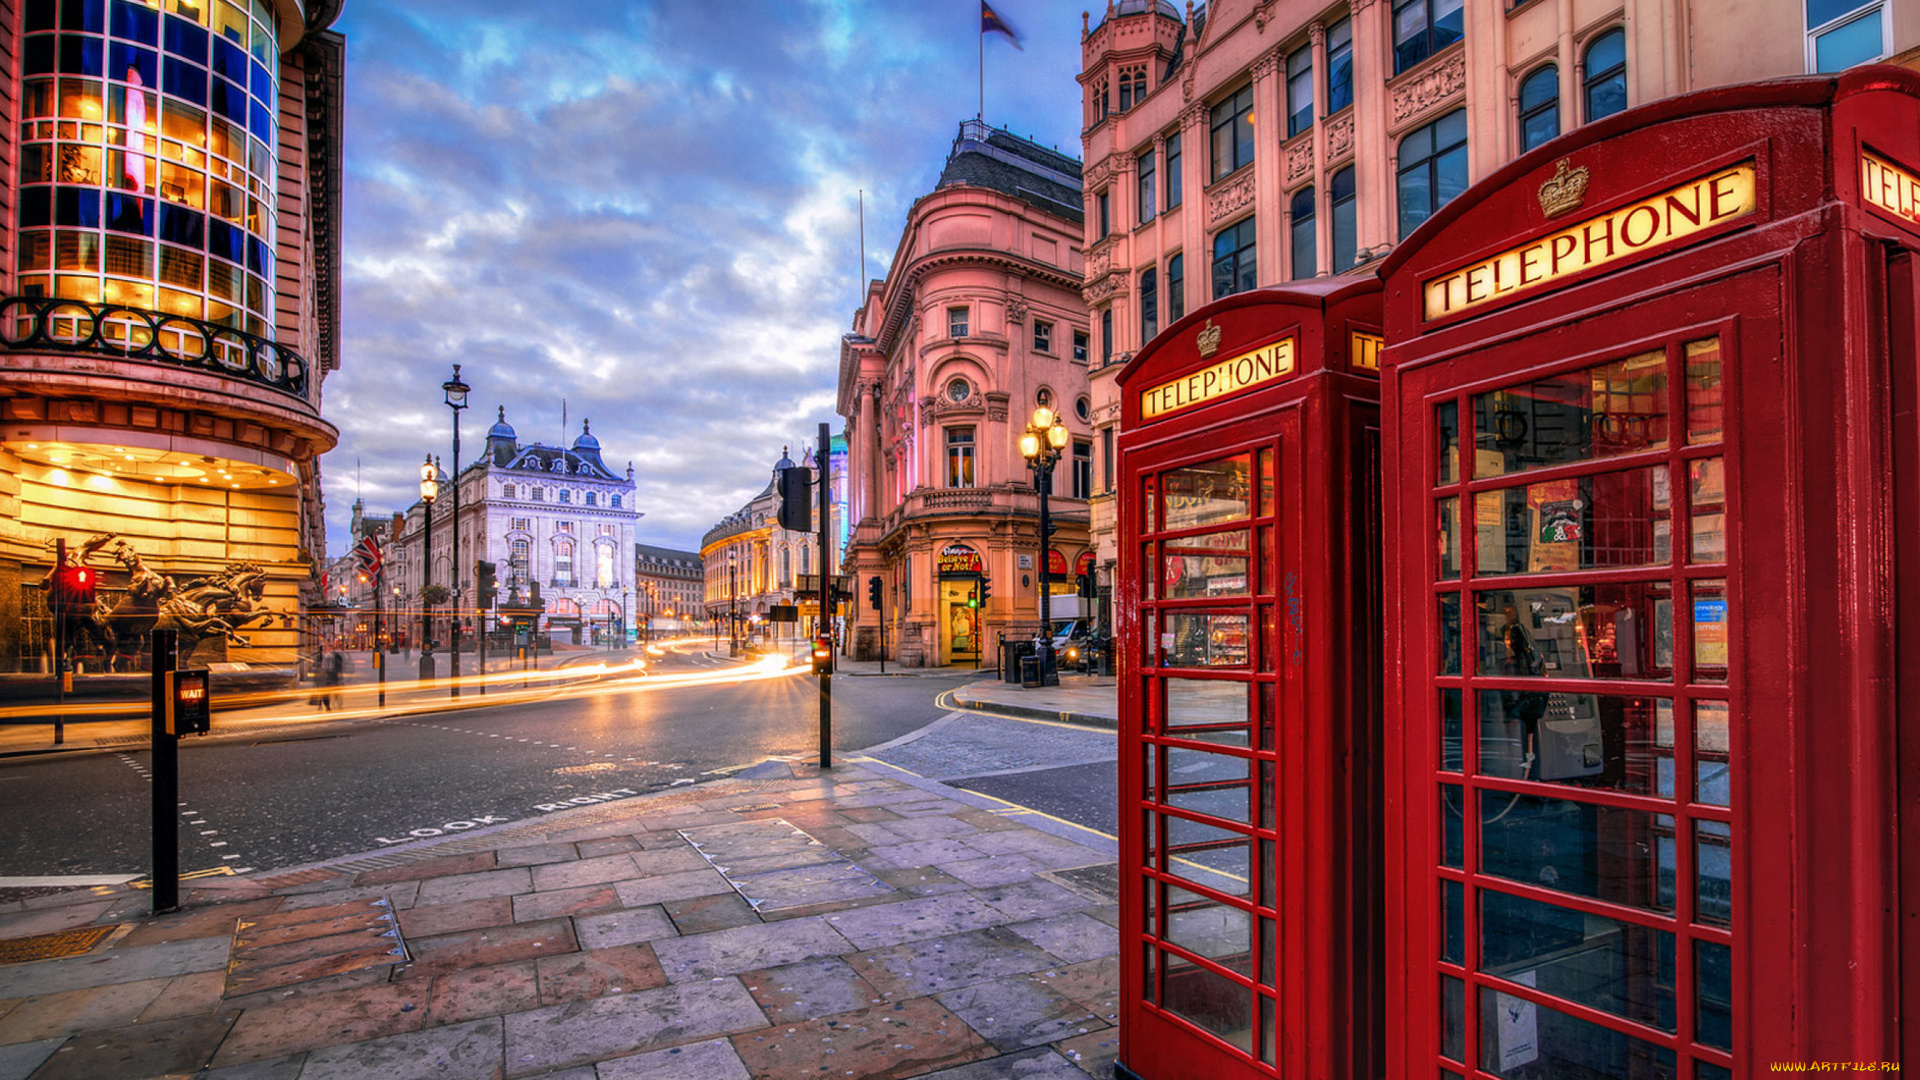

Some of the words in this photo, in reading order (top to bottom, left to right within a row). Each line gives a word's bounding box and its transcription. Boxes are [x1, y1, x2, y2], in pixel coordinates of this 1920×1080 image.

[1433, 171, 1741, 312] TELEPHONE
[1147, 343, 1289, 414] TELEPHONE
[937, 555, 969, 564] Believe
[180, 689, 203, 699] WAIT
[374, 815, 509, 844] LOOK
[532, 788, 638, 811] RIGHT
